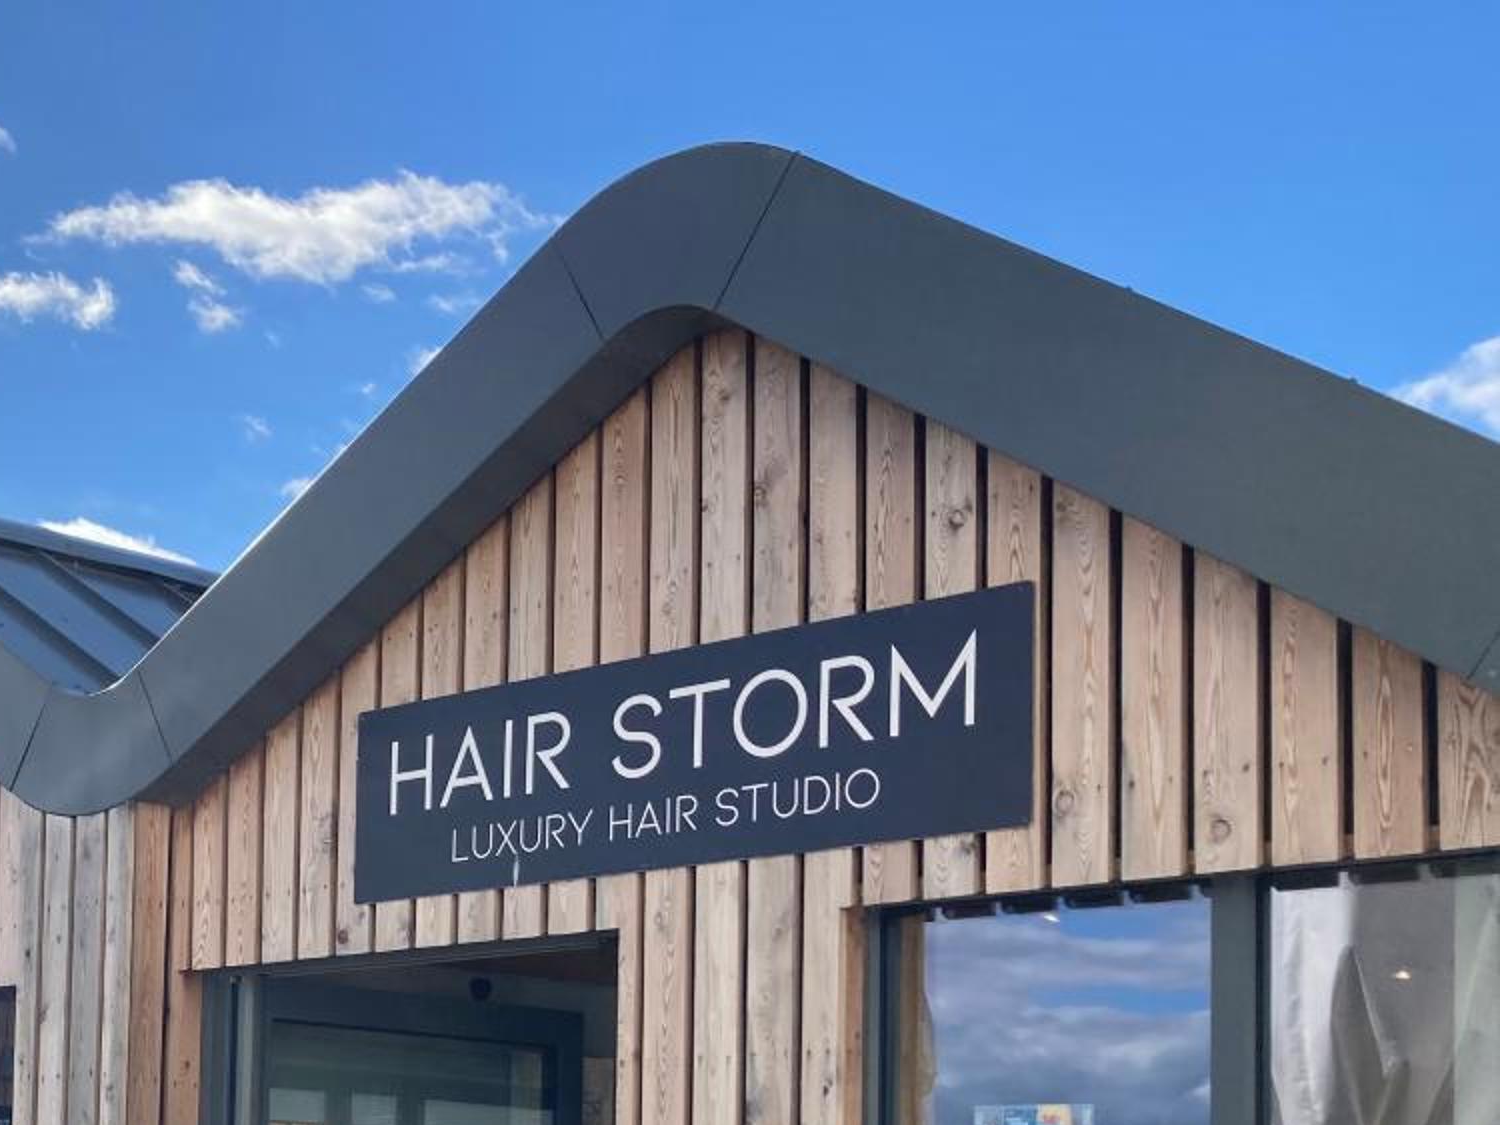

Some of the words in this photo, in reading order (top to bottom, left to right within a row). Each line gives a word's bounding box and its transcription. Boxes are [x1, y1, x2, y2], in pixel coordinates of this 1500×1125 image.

[389, 711, 572, 816] HAIR
[611, 628, 978, 779] STORM
[451, 809, 594, 864] LUXURY
[608, 795, 699, 842] HAIR
[714, 768, 882, 828] STUDIO
